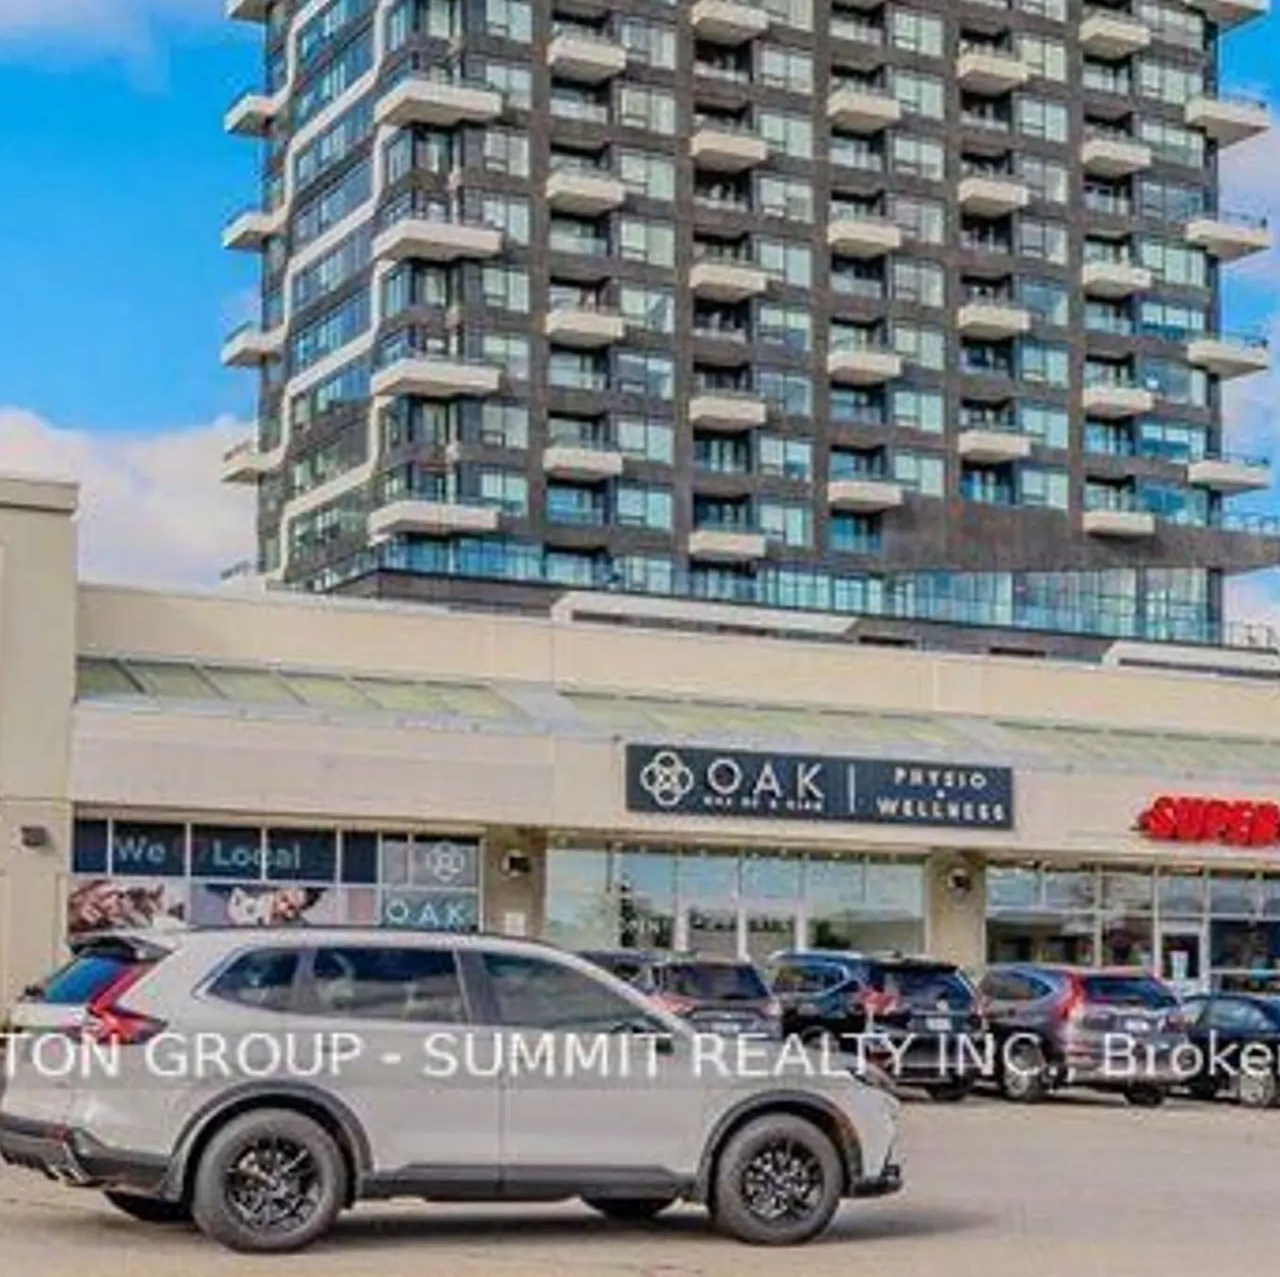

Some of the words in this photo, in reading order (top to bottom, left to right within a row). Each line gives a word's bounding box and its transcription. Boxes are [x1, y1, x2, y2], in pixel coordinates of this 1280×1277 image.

[707, 758, 825, 800] OAK
[893, 766, 987, 790] PHYSIO
[875, 795, 1006, 821] WELLNESS
[116, 836, 167, 865] We
[212, 840, 301, 870] Local
